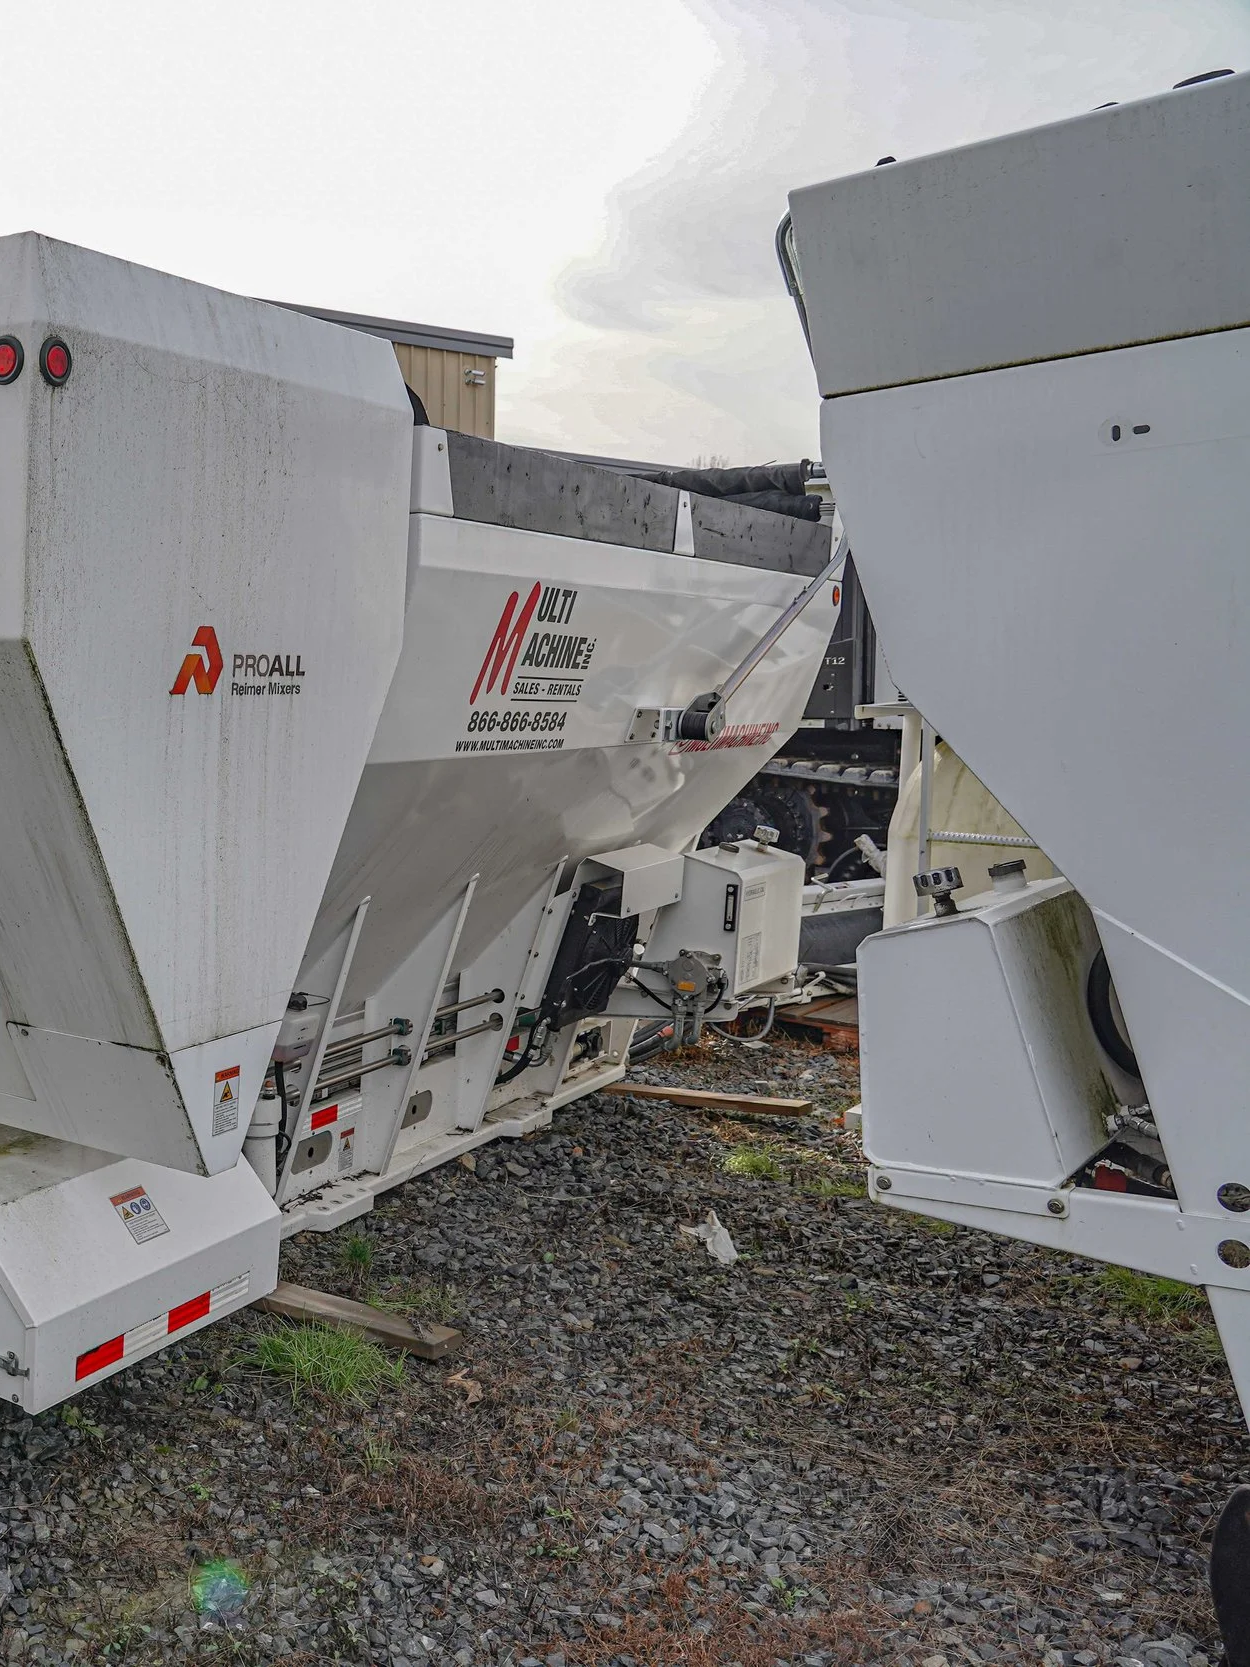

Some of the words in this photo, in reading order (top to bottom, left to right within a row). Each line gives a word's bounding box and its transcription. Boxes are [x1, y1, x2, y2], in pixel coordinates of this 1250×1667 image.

[231, 653, 306, 678] PROALL
[231, 682, 267, 696] Reimer
[267, 681, 301, 696] Mixers
[513, 681, 541, 695] SALES
[546, 683, 582, 696] RENTALS
[467, 710, 568, 733] 866-866-8584
[455, 738, 565, 752] WWW.MULTIMACHINEINC.COM
